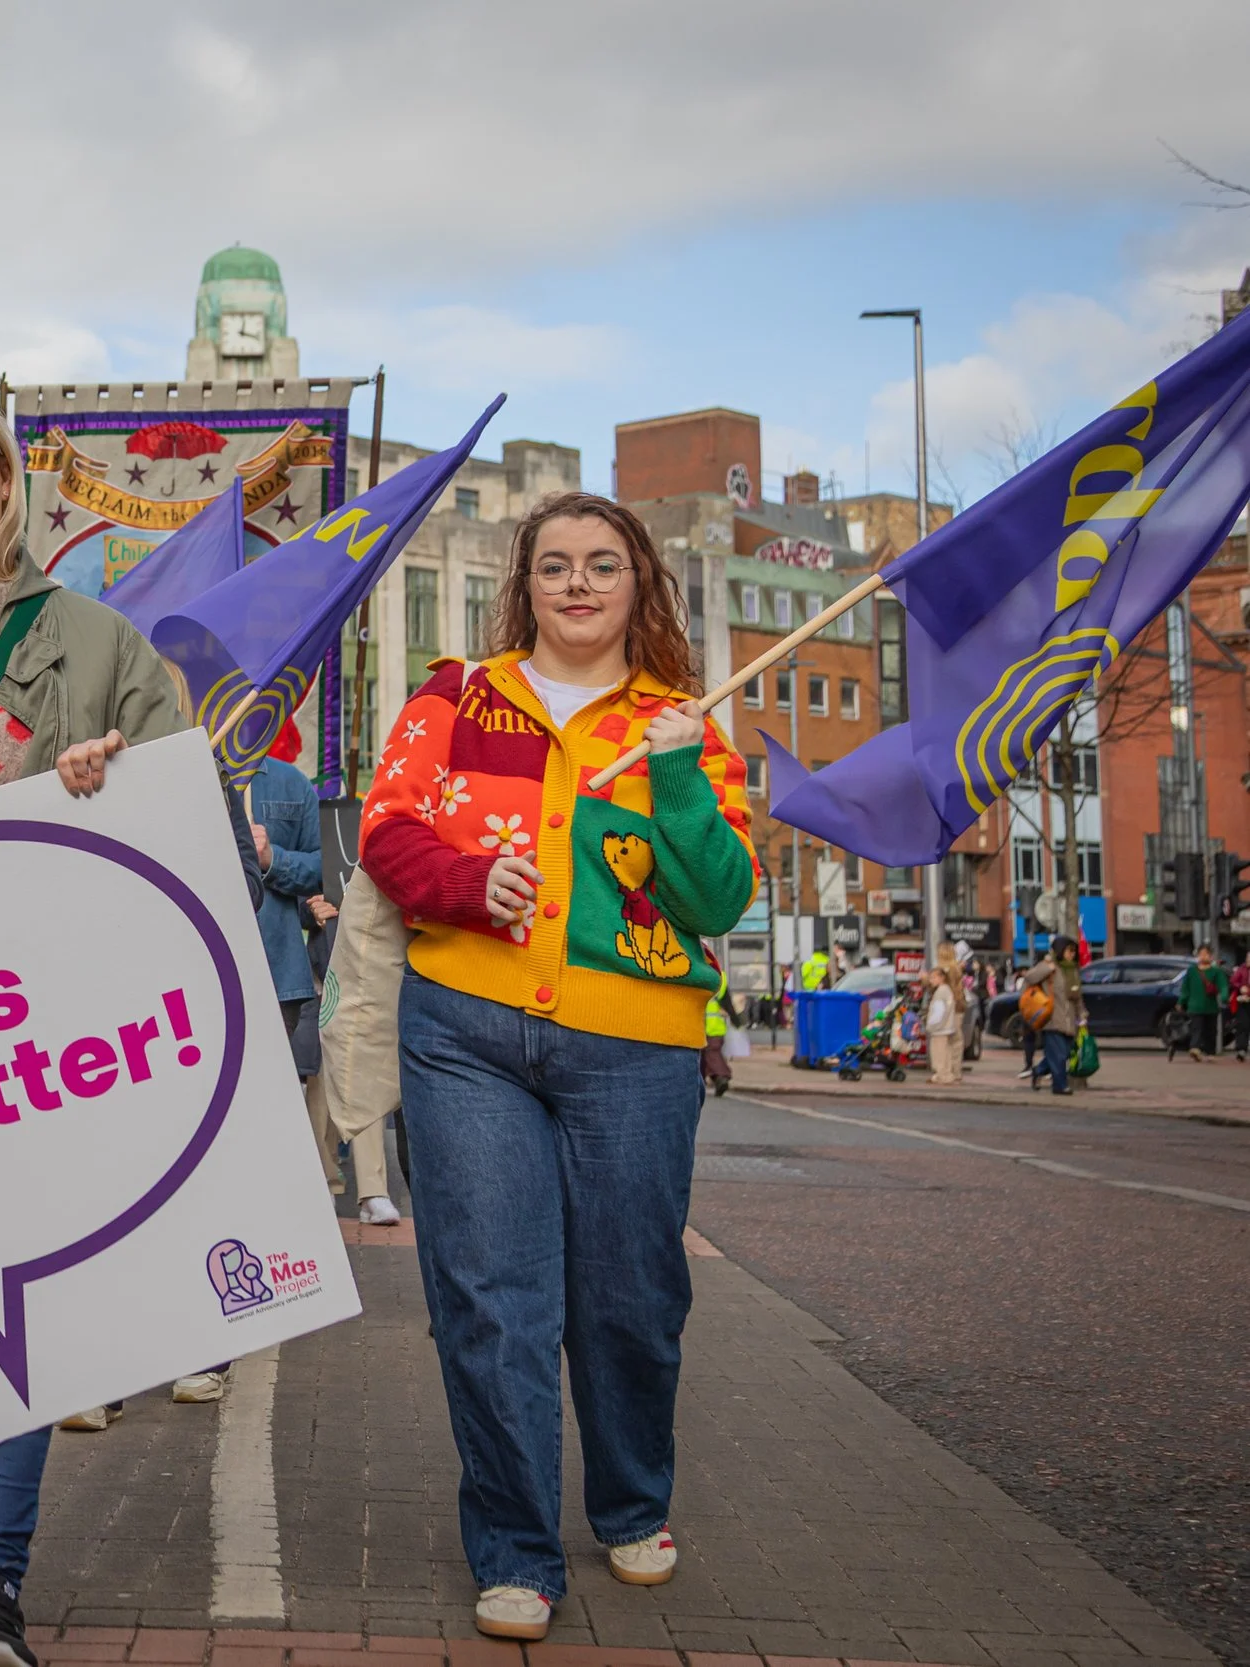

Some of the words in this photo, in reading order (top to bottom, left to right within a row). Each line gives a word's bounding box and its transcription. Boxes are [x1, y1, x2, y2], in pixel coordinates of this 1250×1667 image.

[64, 472, 150, 521] RECLAIM
[162, 507, 189, 521] the
[244, 472, 289, 506] NDA
[108, 538, 151, 563] Child
[266, 1252, 289, 1264] The
[270, 1259, 317, 1284] Mas
[274, 1273, 321, 1296] Project
[227, 1310, 255, 1324] Maternal
[255, 1302, 285, 1314] Advocacy
[285, 1294, 299, 1303] and
[298, 1287, 323, 1299] Support
